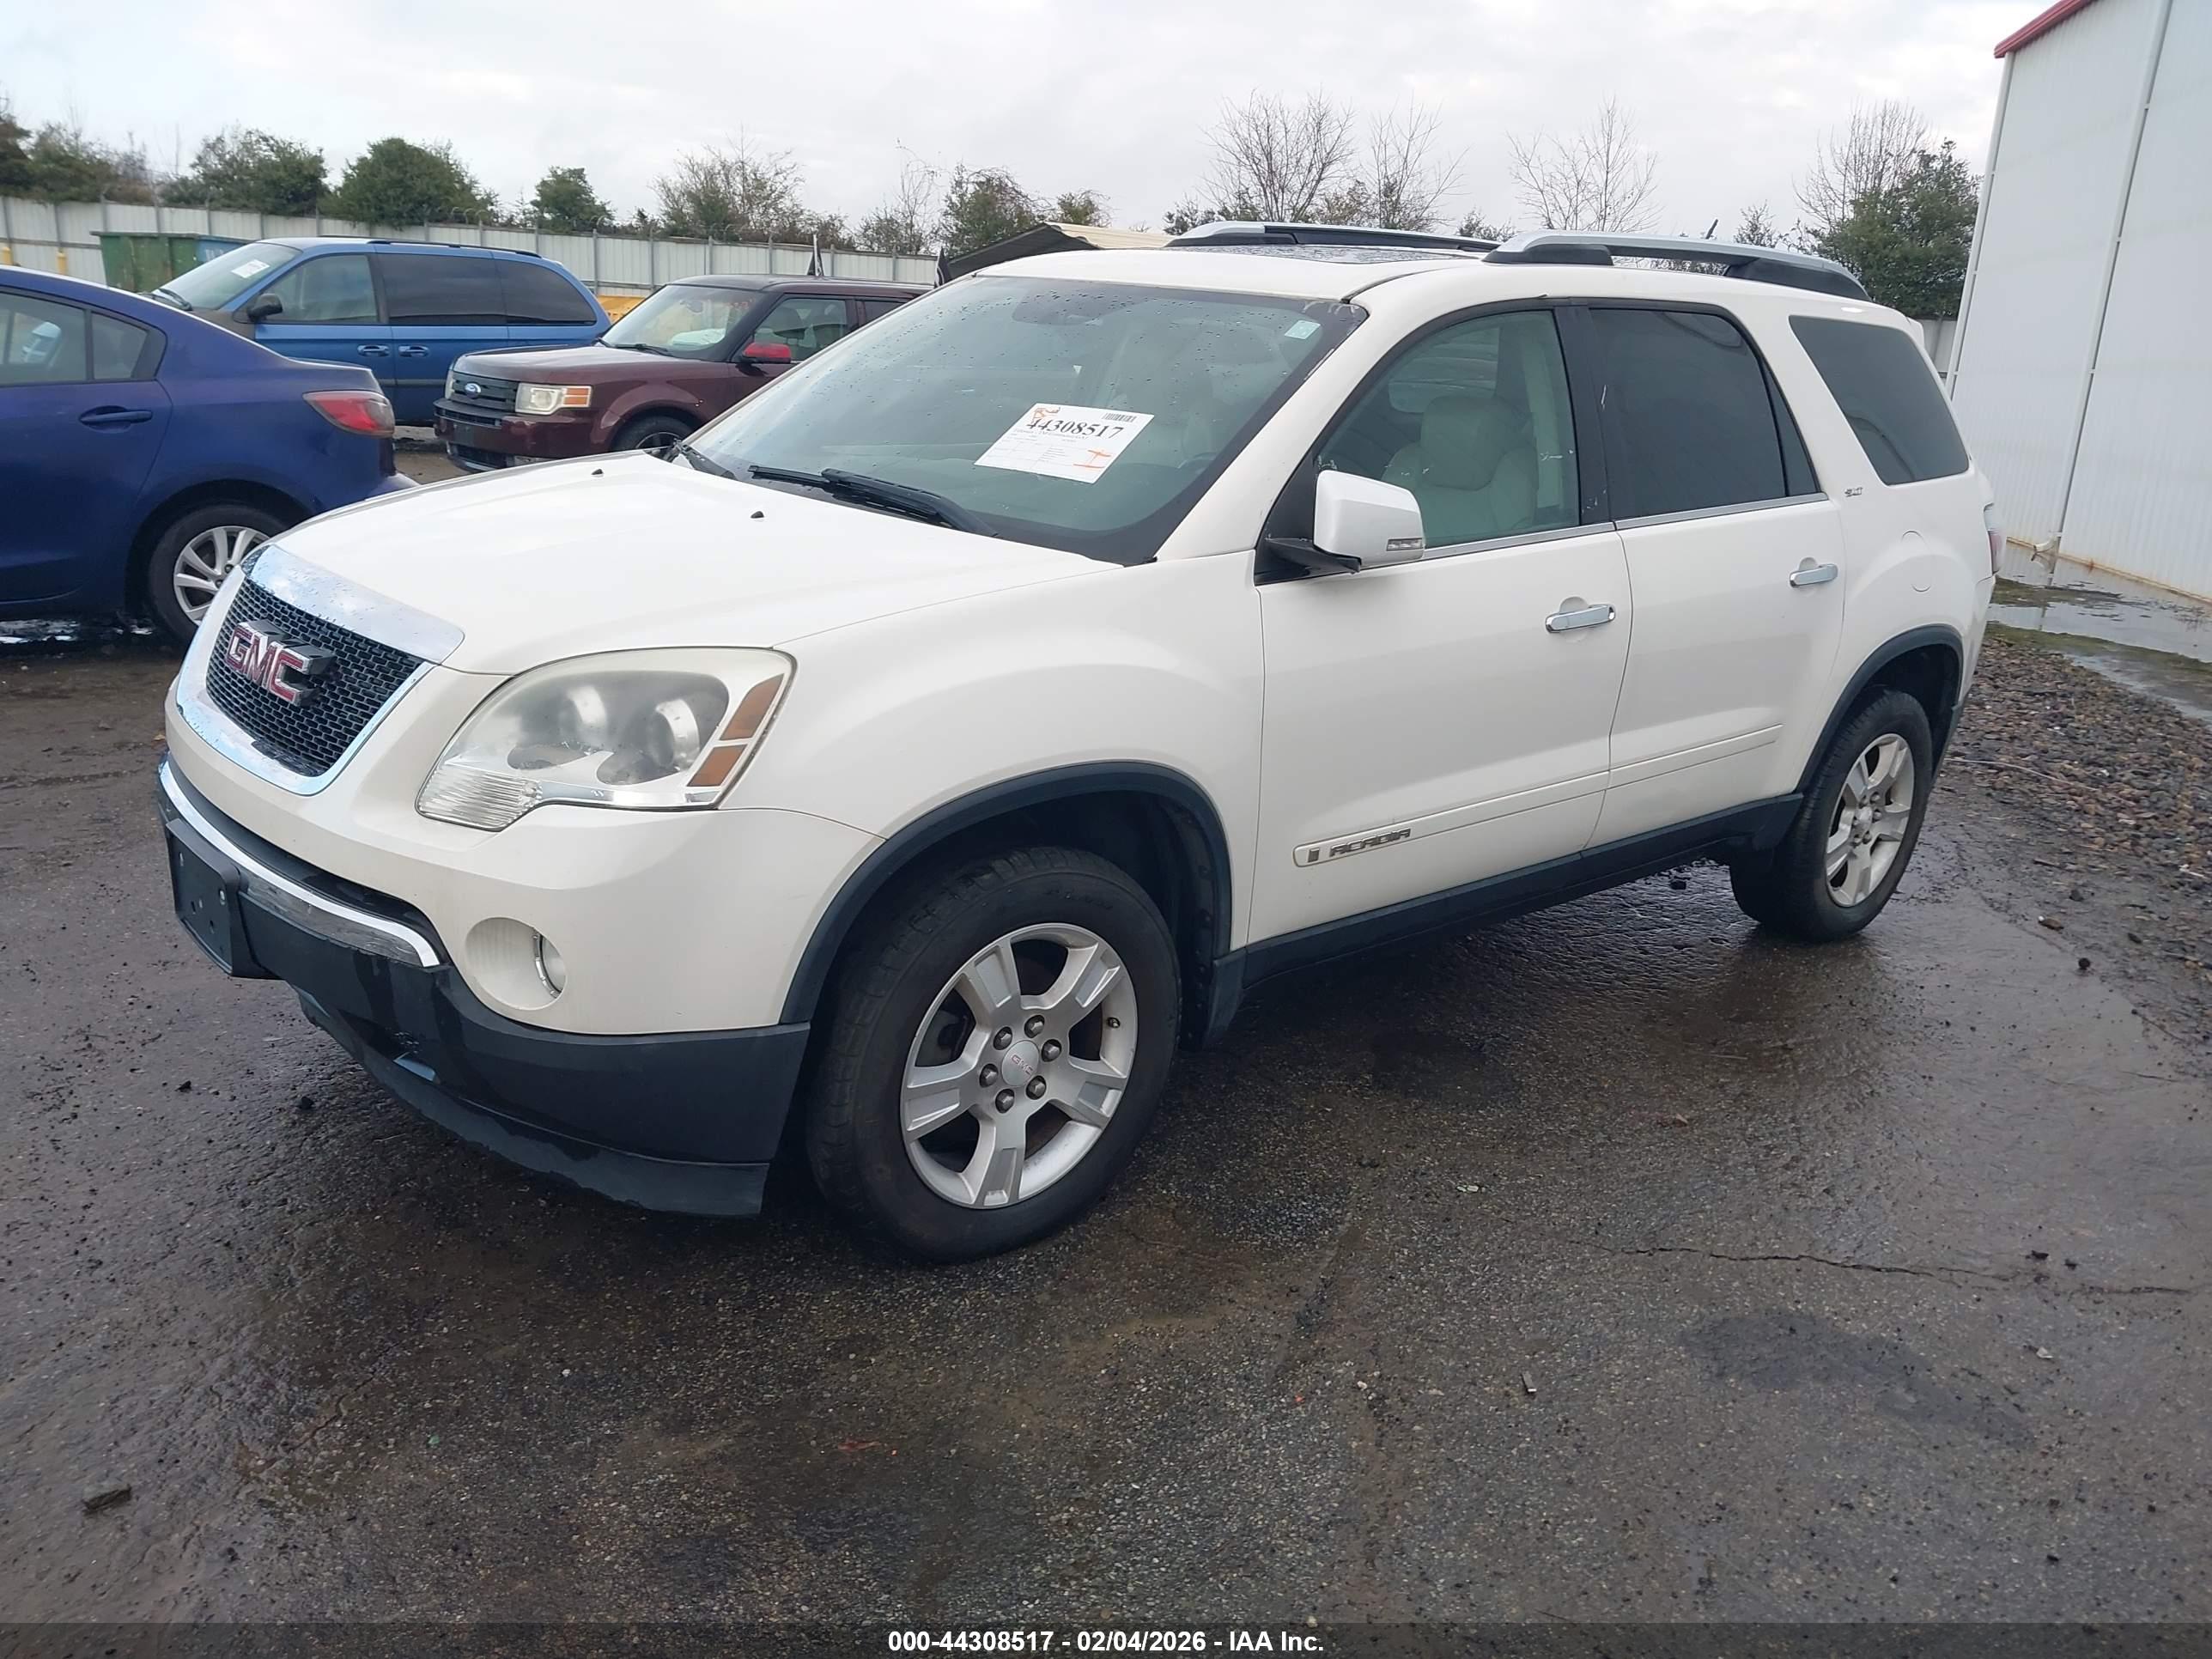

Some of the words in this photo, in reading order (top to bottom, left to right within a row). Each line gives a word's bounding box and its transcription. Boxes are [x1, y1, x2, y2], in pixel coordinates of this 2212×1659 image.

[1026, 418, 1124, 440] 44308517
[225, 622, 310, 706] GMC
[1011, 1054, 1034, 1076] GMC
